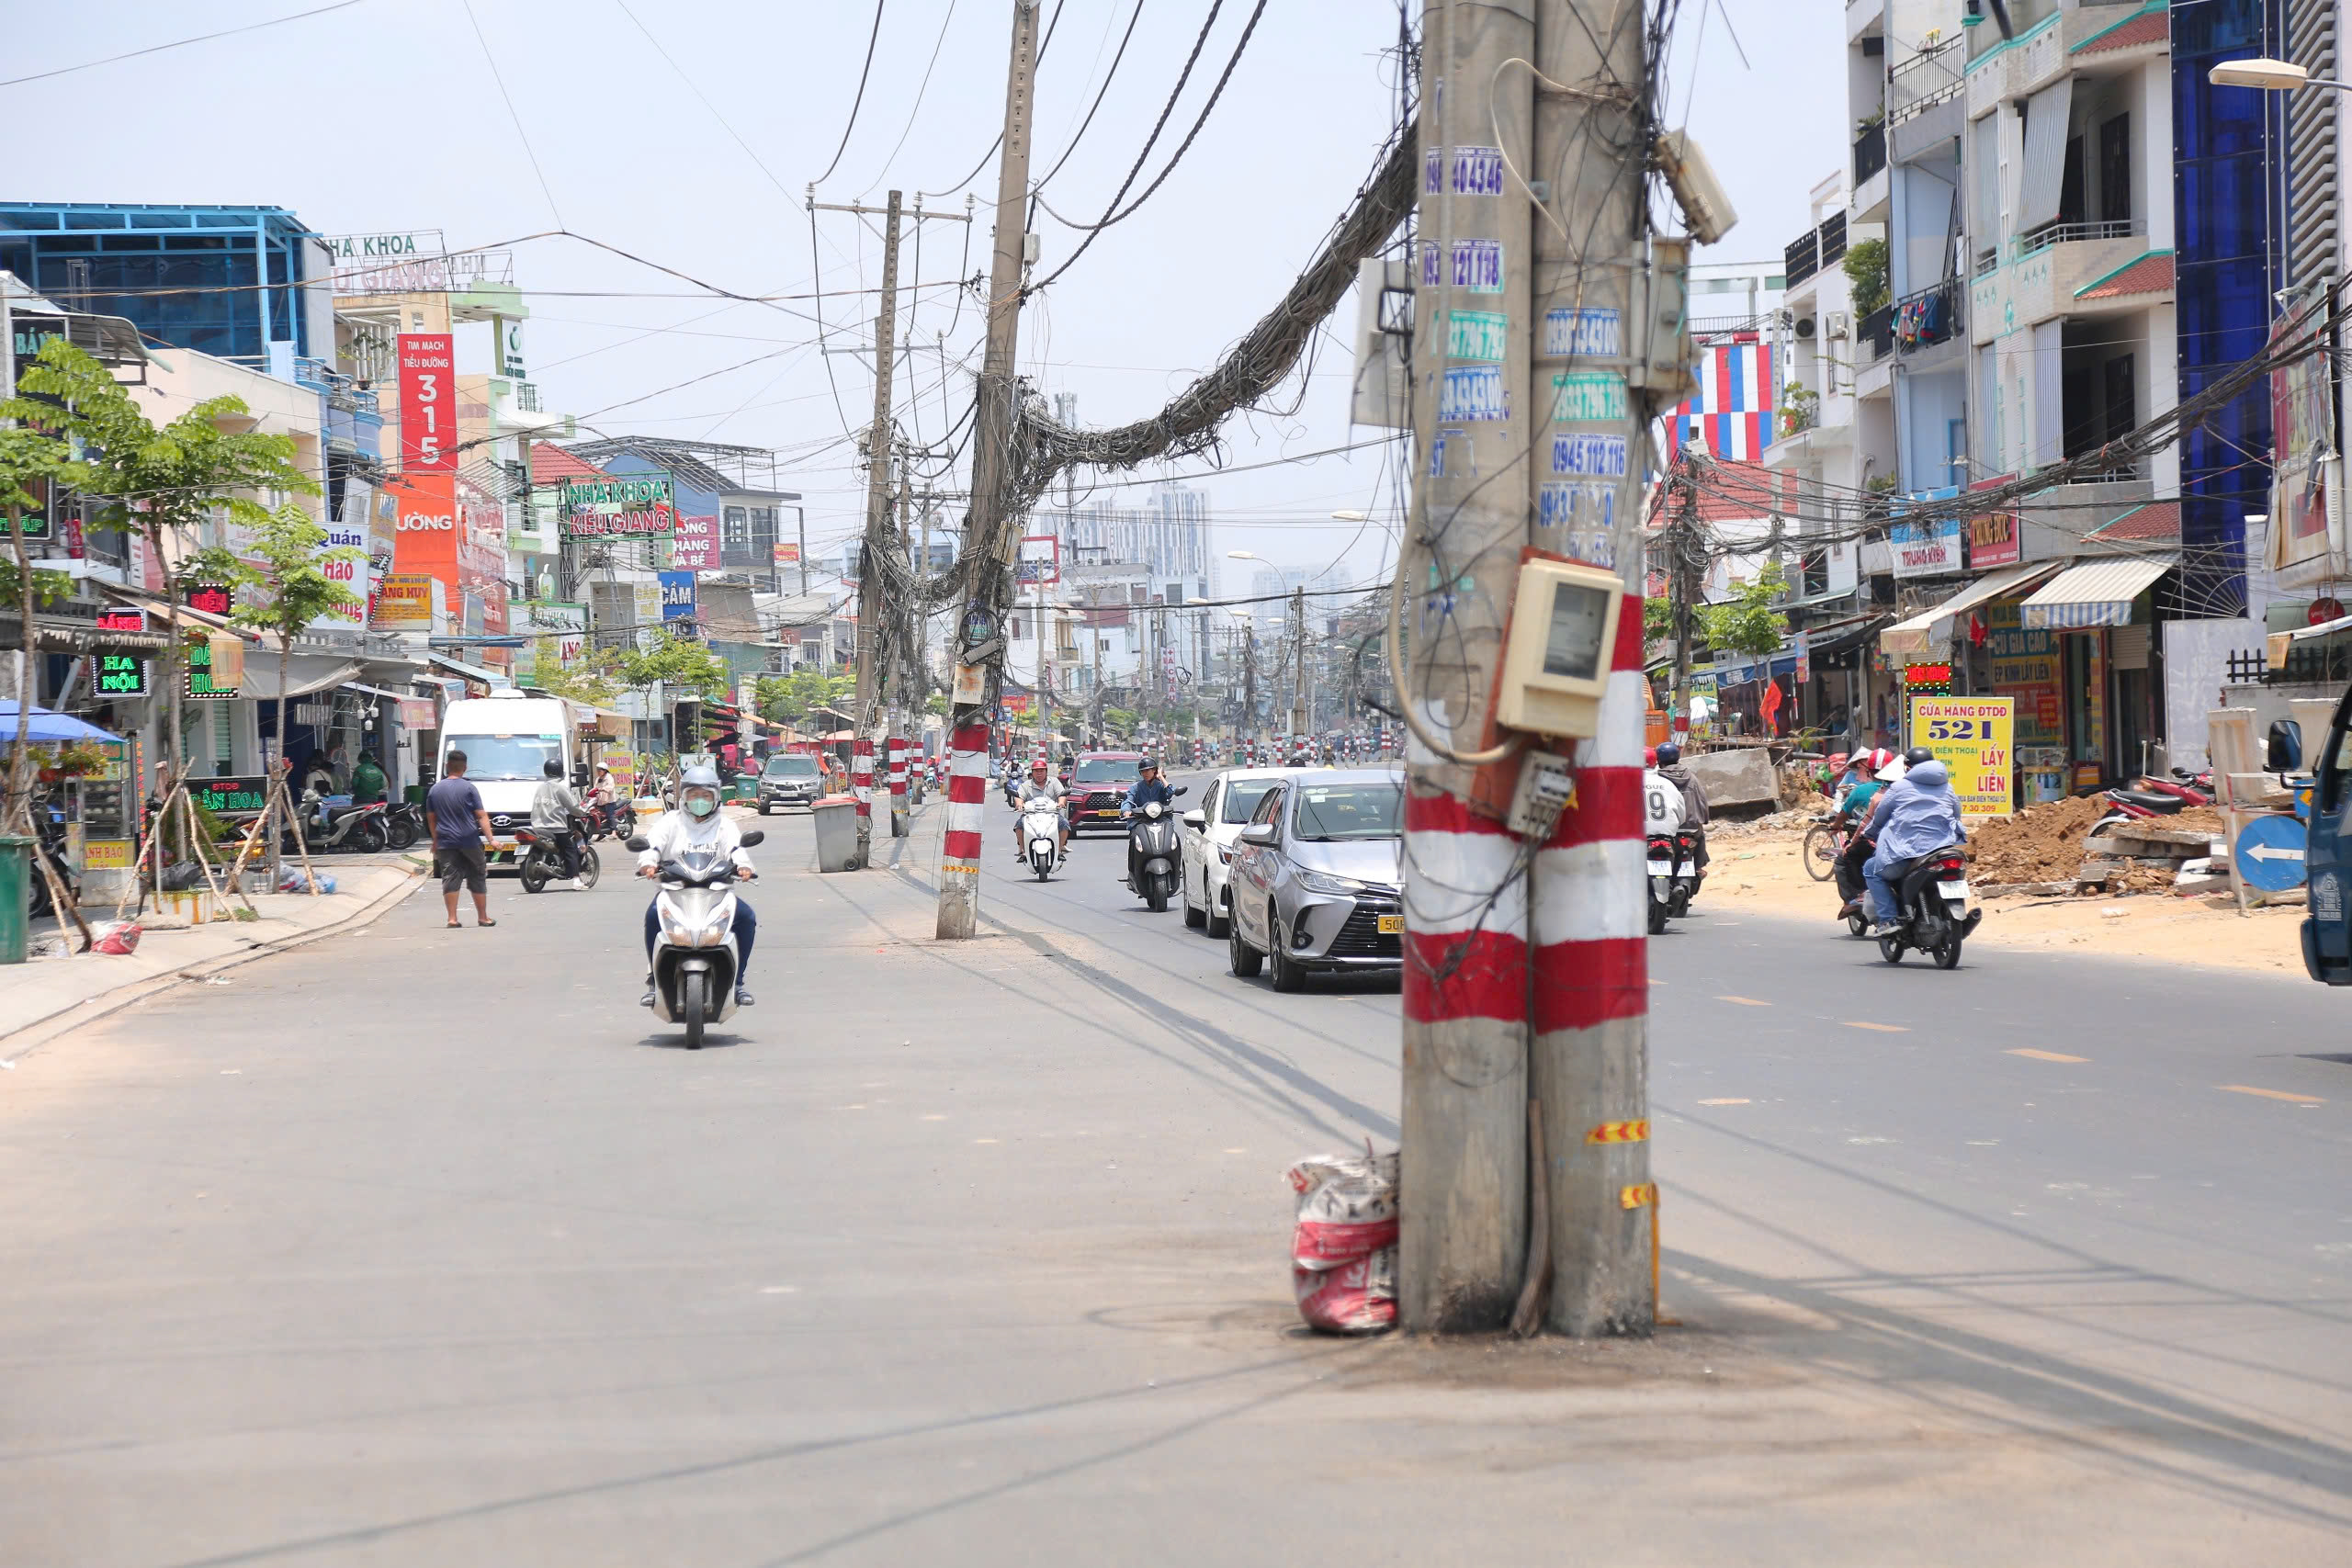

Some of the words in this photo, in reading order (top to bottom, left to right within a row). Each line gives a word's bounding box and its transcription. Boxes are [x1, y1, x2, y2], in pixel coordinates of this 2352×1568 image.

[329, 238, 354, 257] HA
[364, 235, 415, 255] KHOA
[407, 341, 419, 350] TIM
[422, 341, 445, 353] MẠCH
[403, 354, 420, 367] TIỂU
[422, 356, 448, 367] ĐƯỜNG
[612, 479, 665, 503] KHOA
[395, 511, 452, 532] ƯỜNG
[611, 510, 669, 533] GIANG
[318, 528, 362, 547] Quán
[690, 552, 706, 566] BÉ
[381, 587, 403, 598] ANG
[407, 588, 428, 598] HUY
[2028, 632, 2046, 652] CAO
[102, 672, 140, 694] NỘI
[1918, 702, 1941, 716] CỬA
[1944, 703, 1975, 716] HÀNG
[1978, 705, 2007, 716] ĐTDĐ
[1928, 720, 1992, 740] 521
[1981, 743, 2005, 766] LẤY
[230, 791, 264, 809] HOA
[105, 846, 123, 858] BAO
